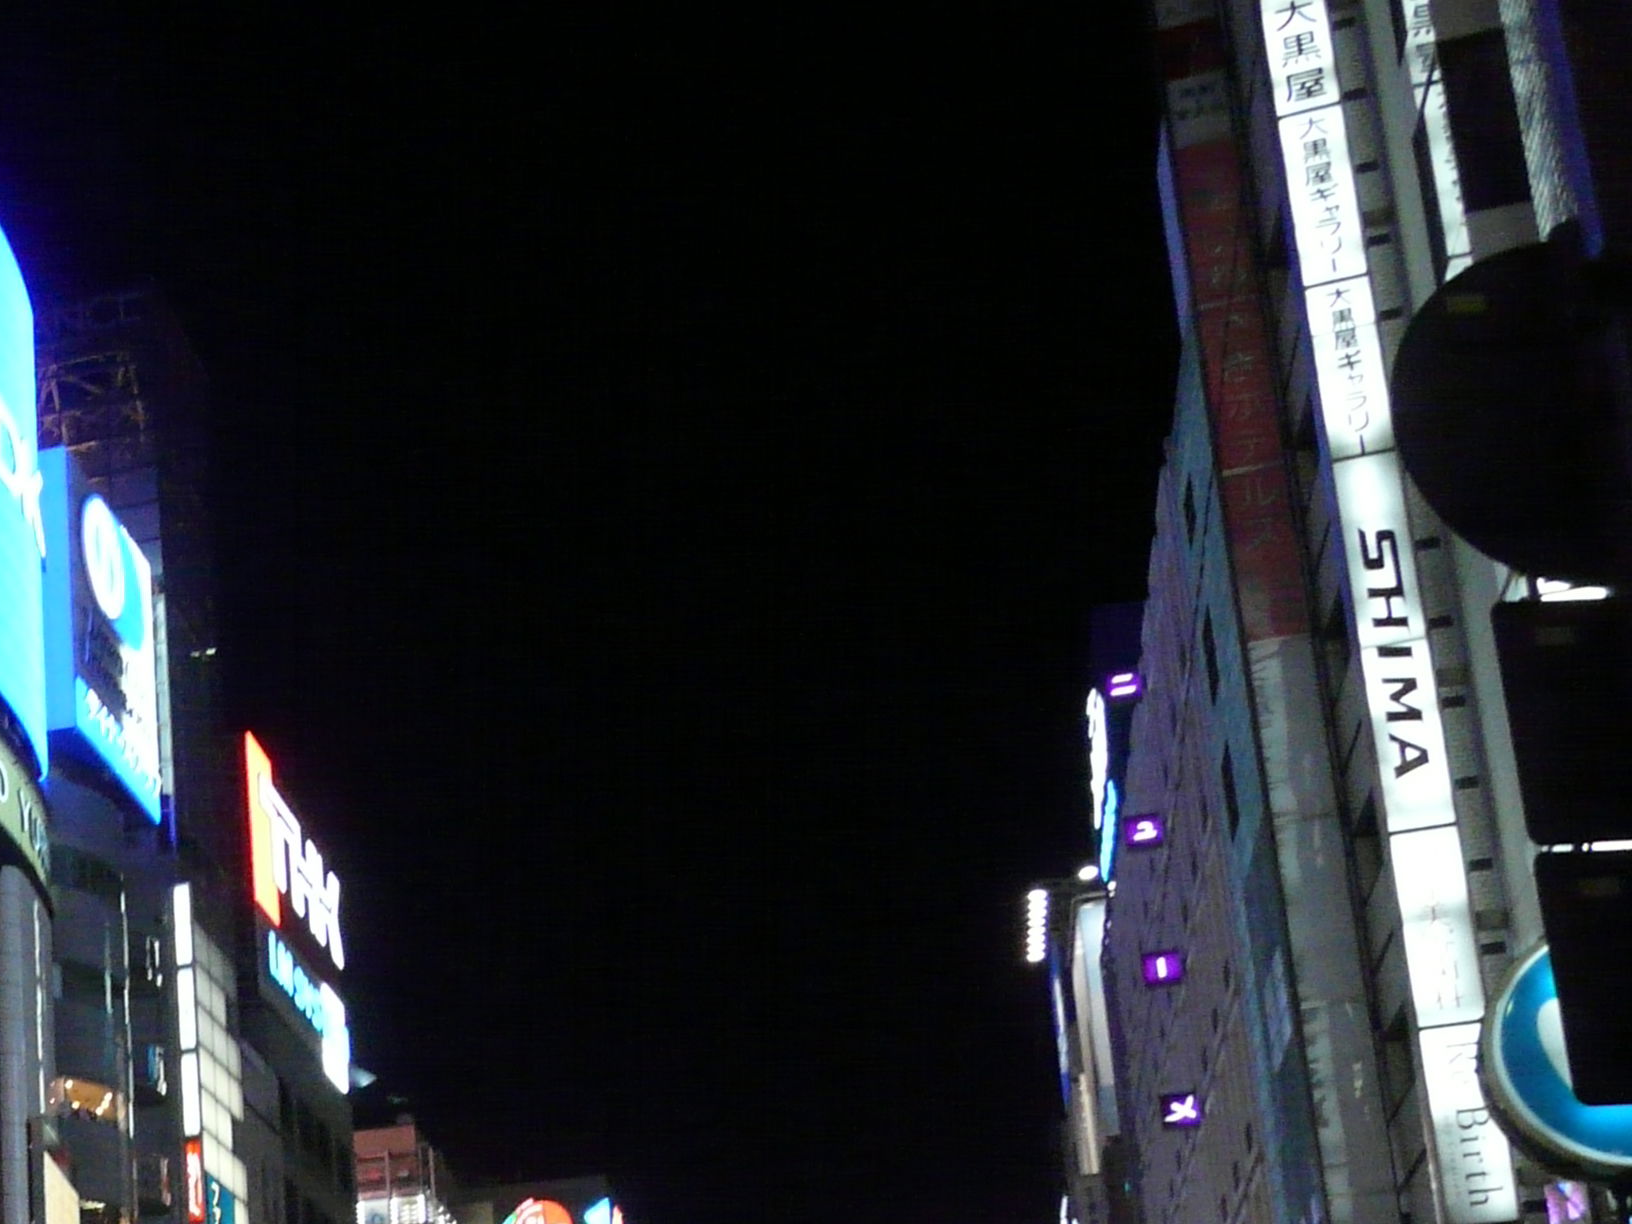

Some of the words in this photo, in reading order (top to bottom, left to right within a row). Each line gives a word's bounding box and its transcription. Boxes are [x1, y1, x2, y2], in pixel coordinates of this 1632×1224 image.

[1298, 116, 1341, 273] 大黒屋ギャラリー
[1325, 287, 1369, 452] 大黒屋ギャラリー
[1357, 528, 1430, 780] SHIMA
[1455, 1104, 1504, 1209] Birth
